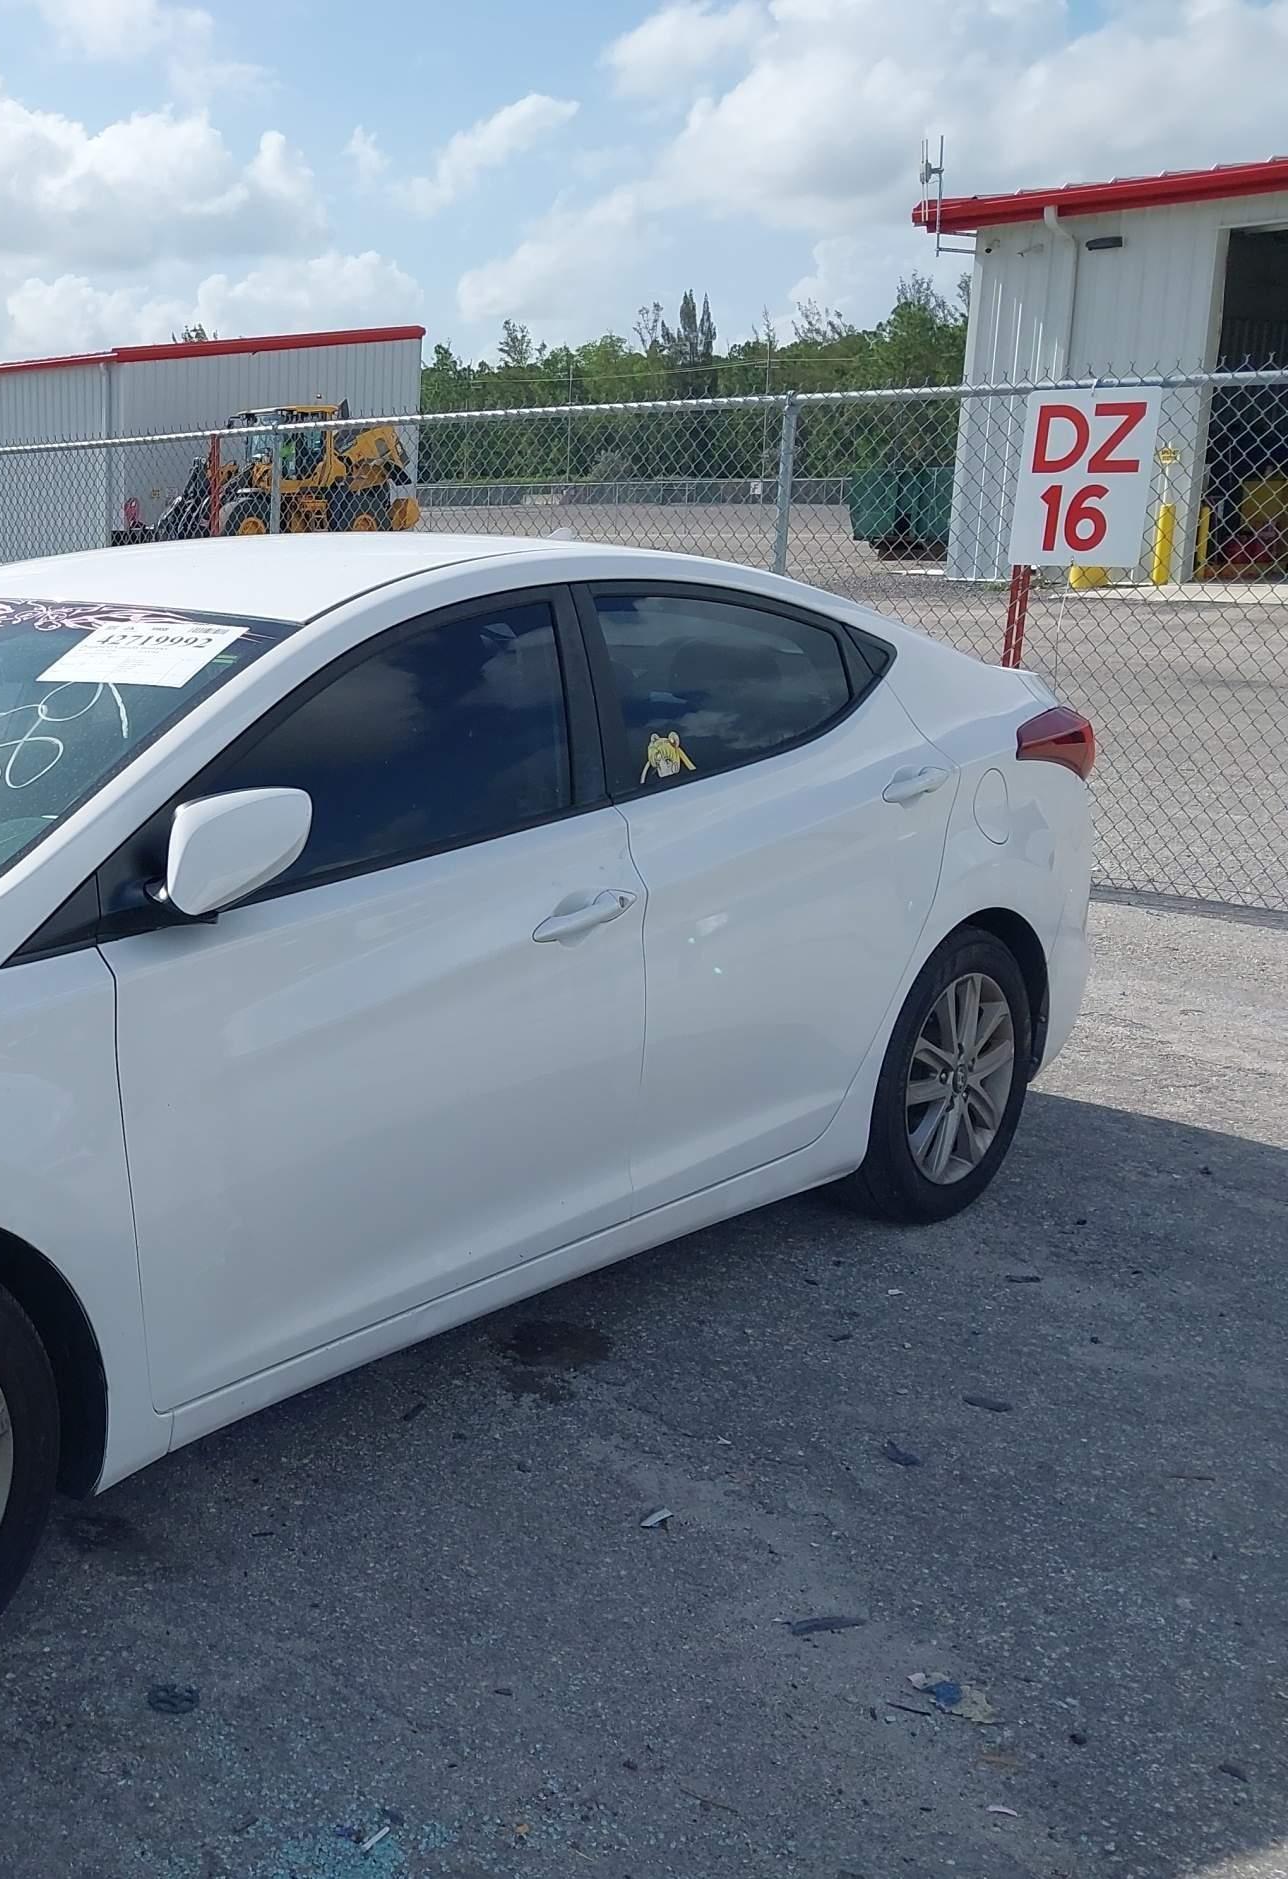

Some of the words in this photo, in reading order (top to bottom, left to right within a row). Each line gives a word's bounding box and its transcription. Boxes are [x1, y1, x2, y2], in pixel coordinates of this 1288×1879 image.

[1032, 402, 1147, 473] DZ
[1040, 484, 1109, 551] 16
[96, 634, 213, 648] 42719992
